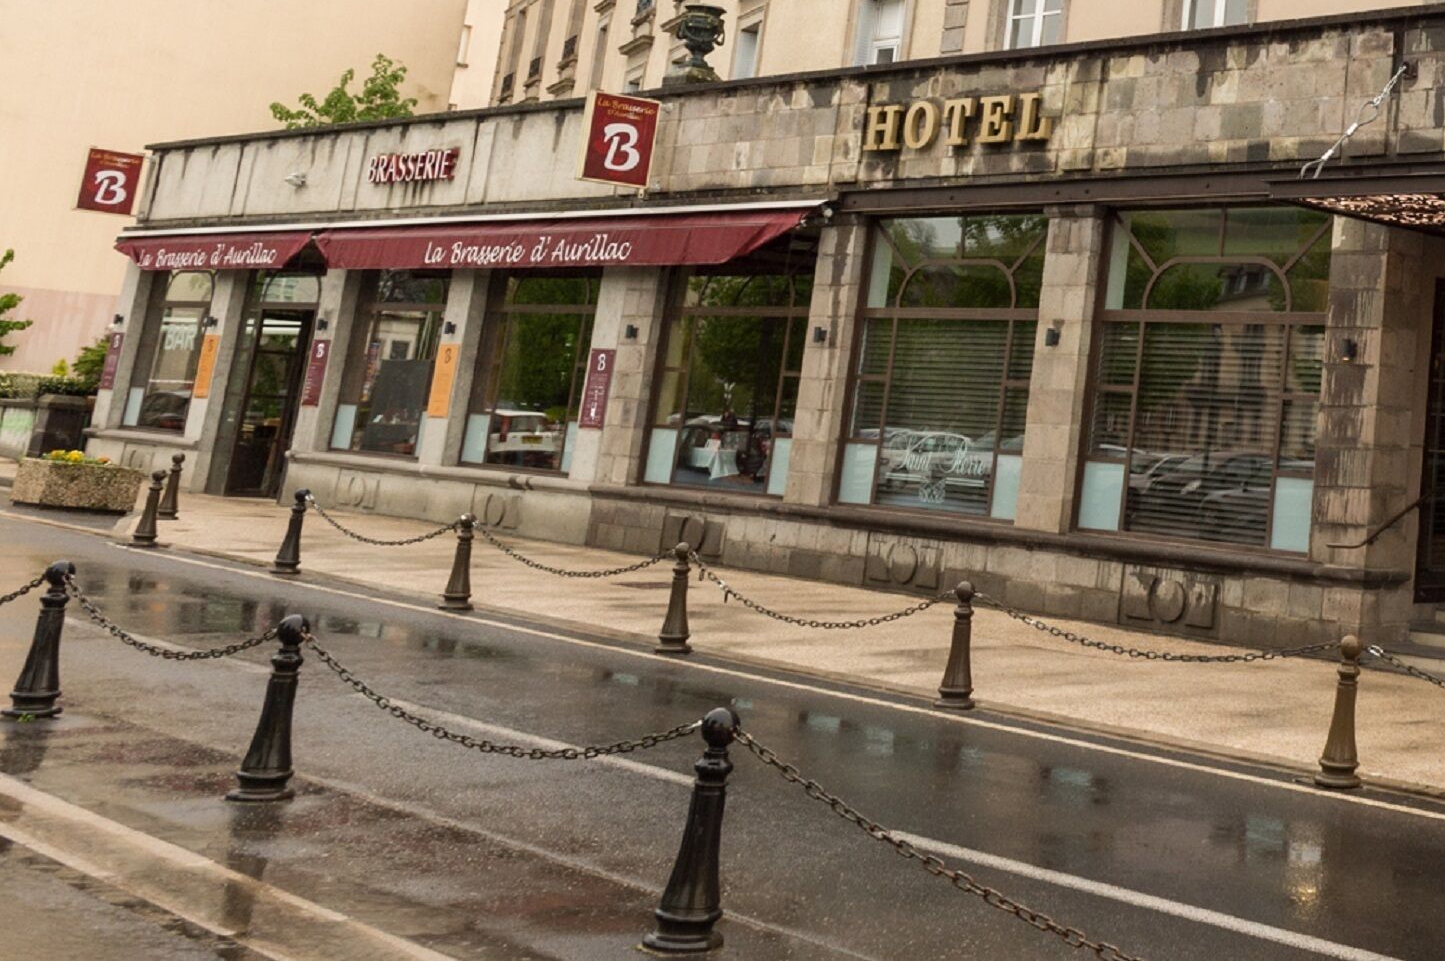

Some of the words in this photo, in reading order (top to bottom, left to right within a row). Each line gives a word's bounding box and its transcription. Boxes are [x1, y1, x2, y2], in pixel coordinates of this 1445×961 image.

[863, 92, 1053, 151] HOTEL
[368, 147, 457, 183] BRASSERIE
[603, 122, 640, 172] B
[94, 169, 127, 205] B
[138, 248, 153, 267] La
[155, 247, 207, 268] Brasserie
[424, 241, 447, 264] La
[450, 240, 525, 265] Brasserie
[530, 233, 632, 263] d'Aurillac
